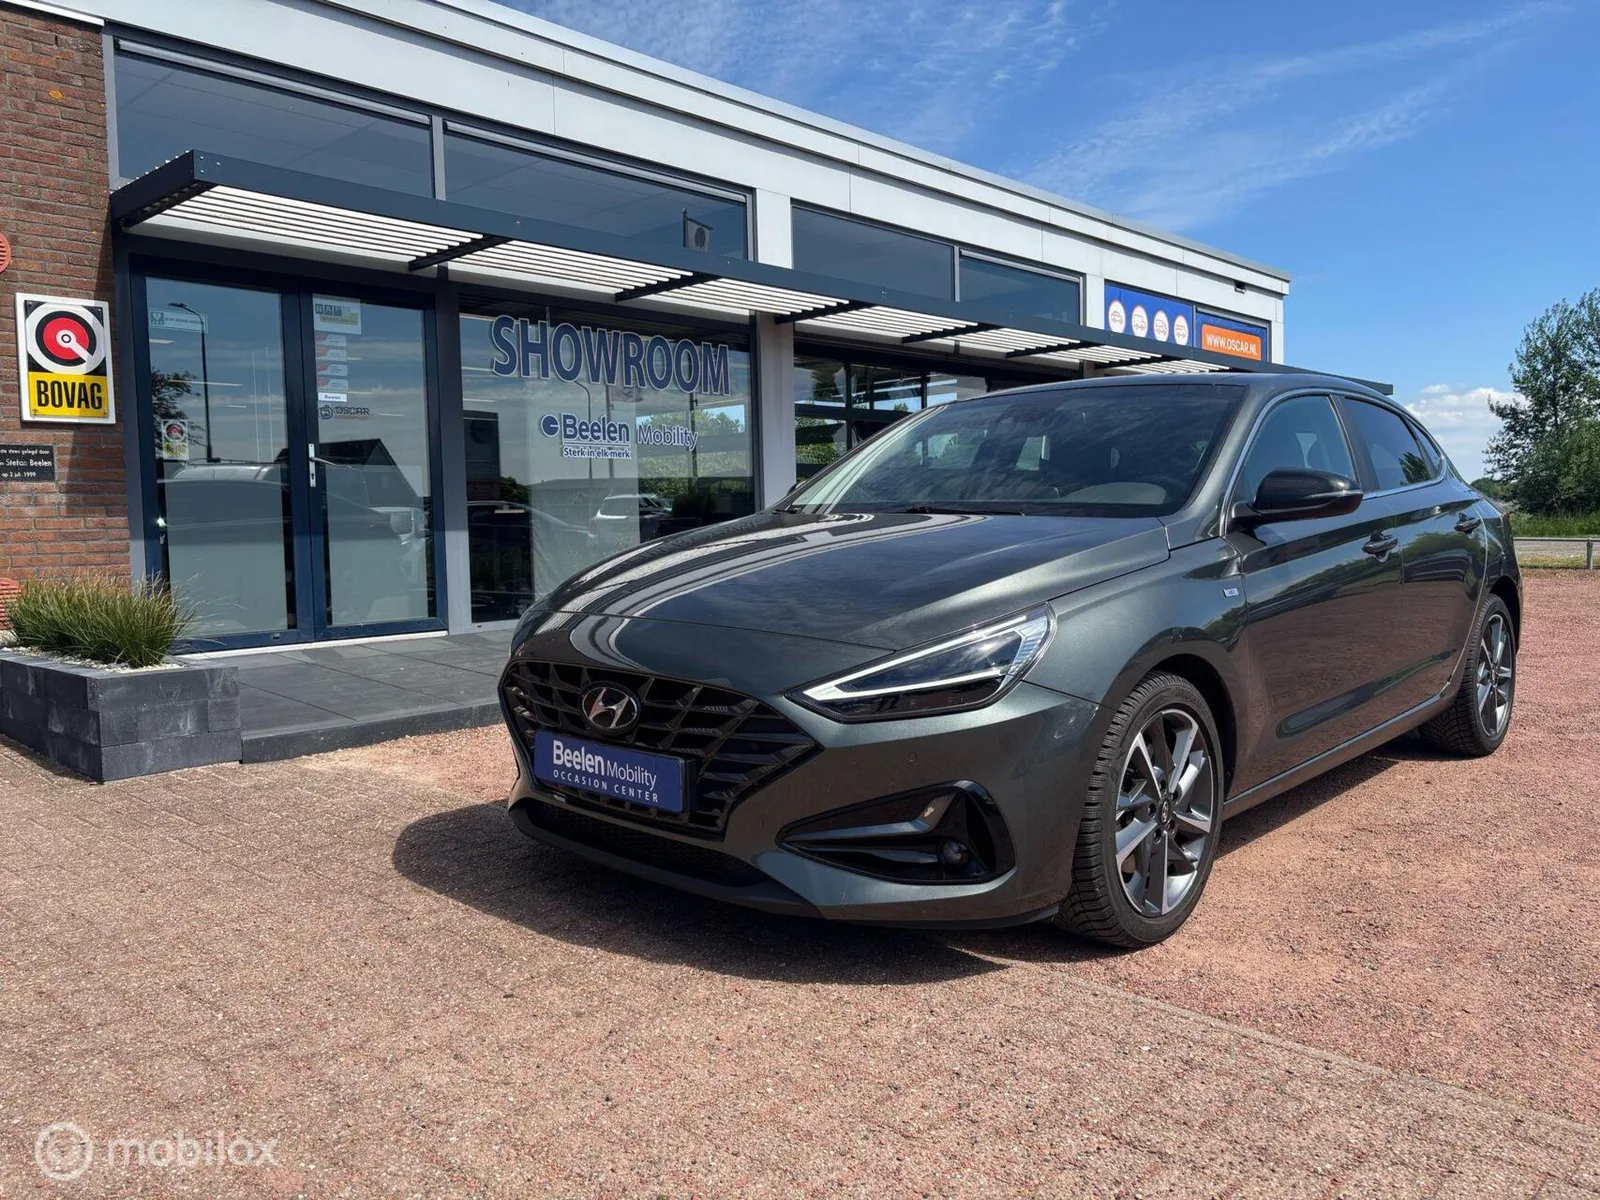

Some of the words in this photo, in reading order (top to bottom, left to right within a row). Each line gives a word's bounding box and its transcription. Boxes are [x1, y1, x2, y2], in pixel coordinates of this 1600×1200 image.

[490, 314, 731, 396] SHOWROOM
[1206, 333, 1258, 356] WWW.OSCAR.NL
[36, 379, 103, 410] BOVAG
[561, 413, 631, 443] Beelen
[636, 423, 698, 450] Mobility
[5, 458, 28, 466] Stefan
[30, 458, 53, 467] Beelen
[563, 446, 586, 458] Sterk
[587, 448, 595, 457] in
[596, 448, 609, 458] elk
[610, 450, 632, 459] merk
[553, 739, 605, 776] Beelen
[606, 759, 657, 791] Mobility
[553, 769, 608, 791] OCCASION
[613, 784, 658, 803] CENTER
